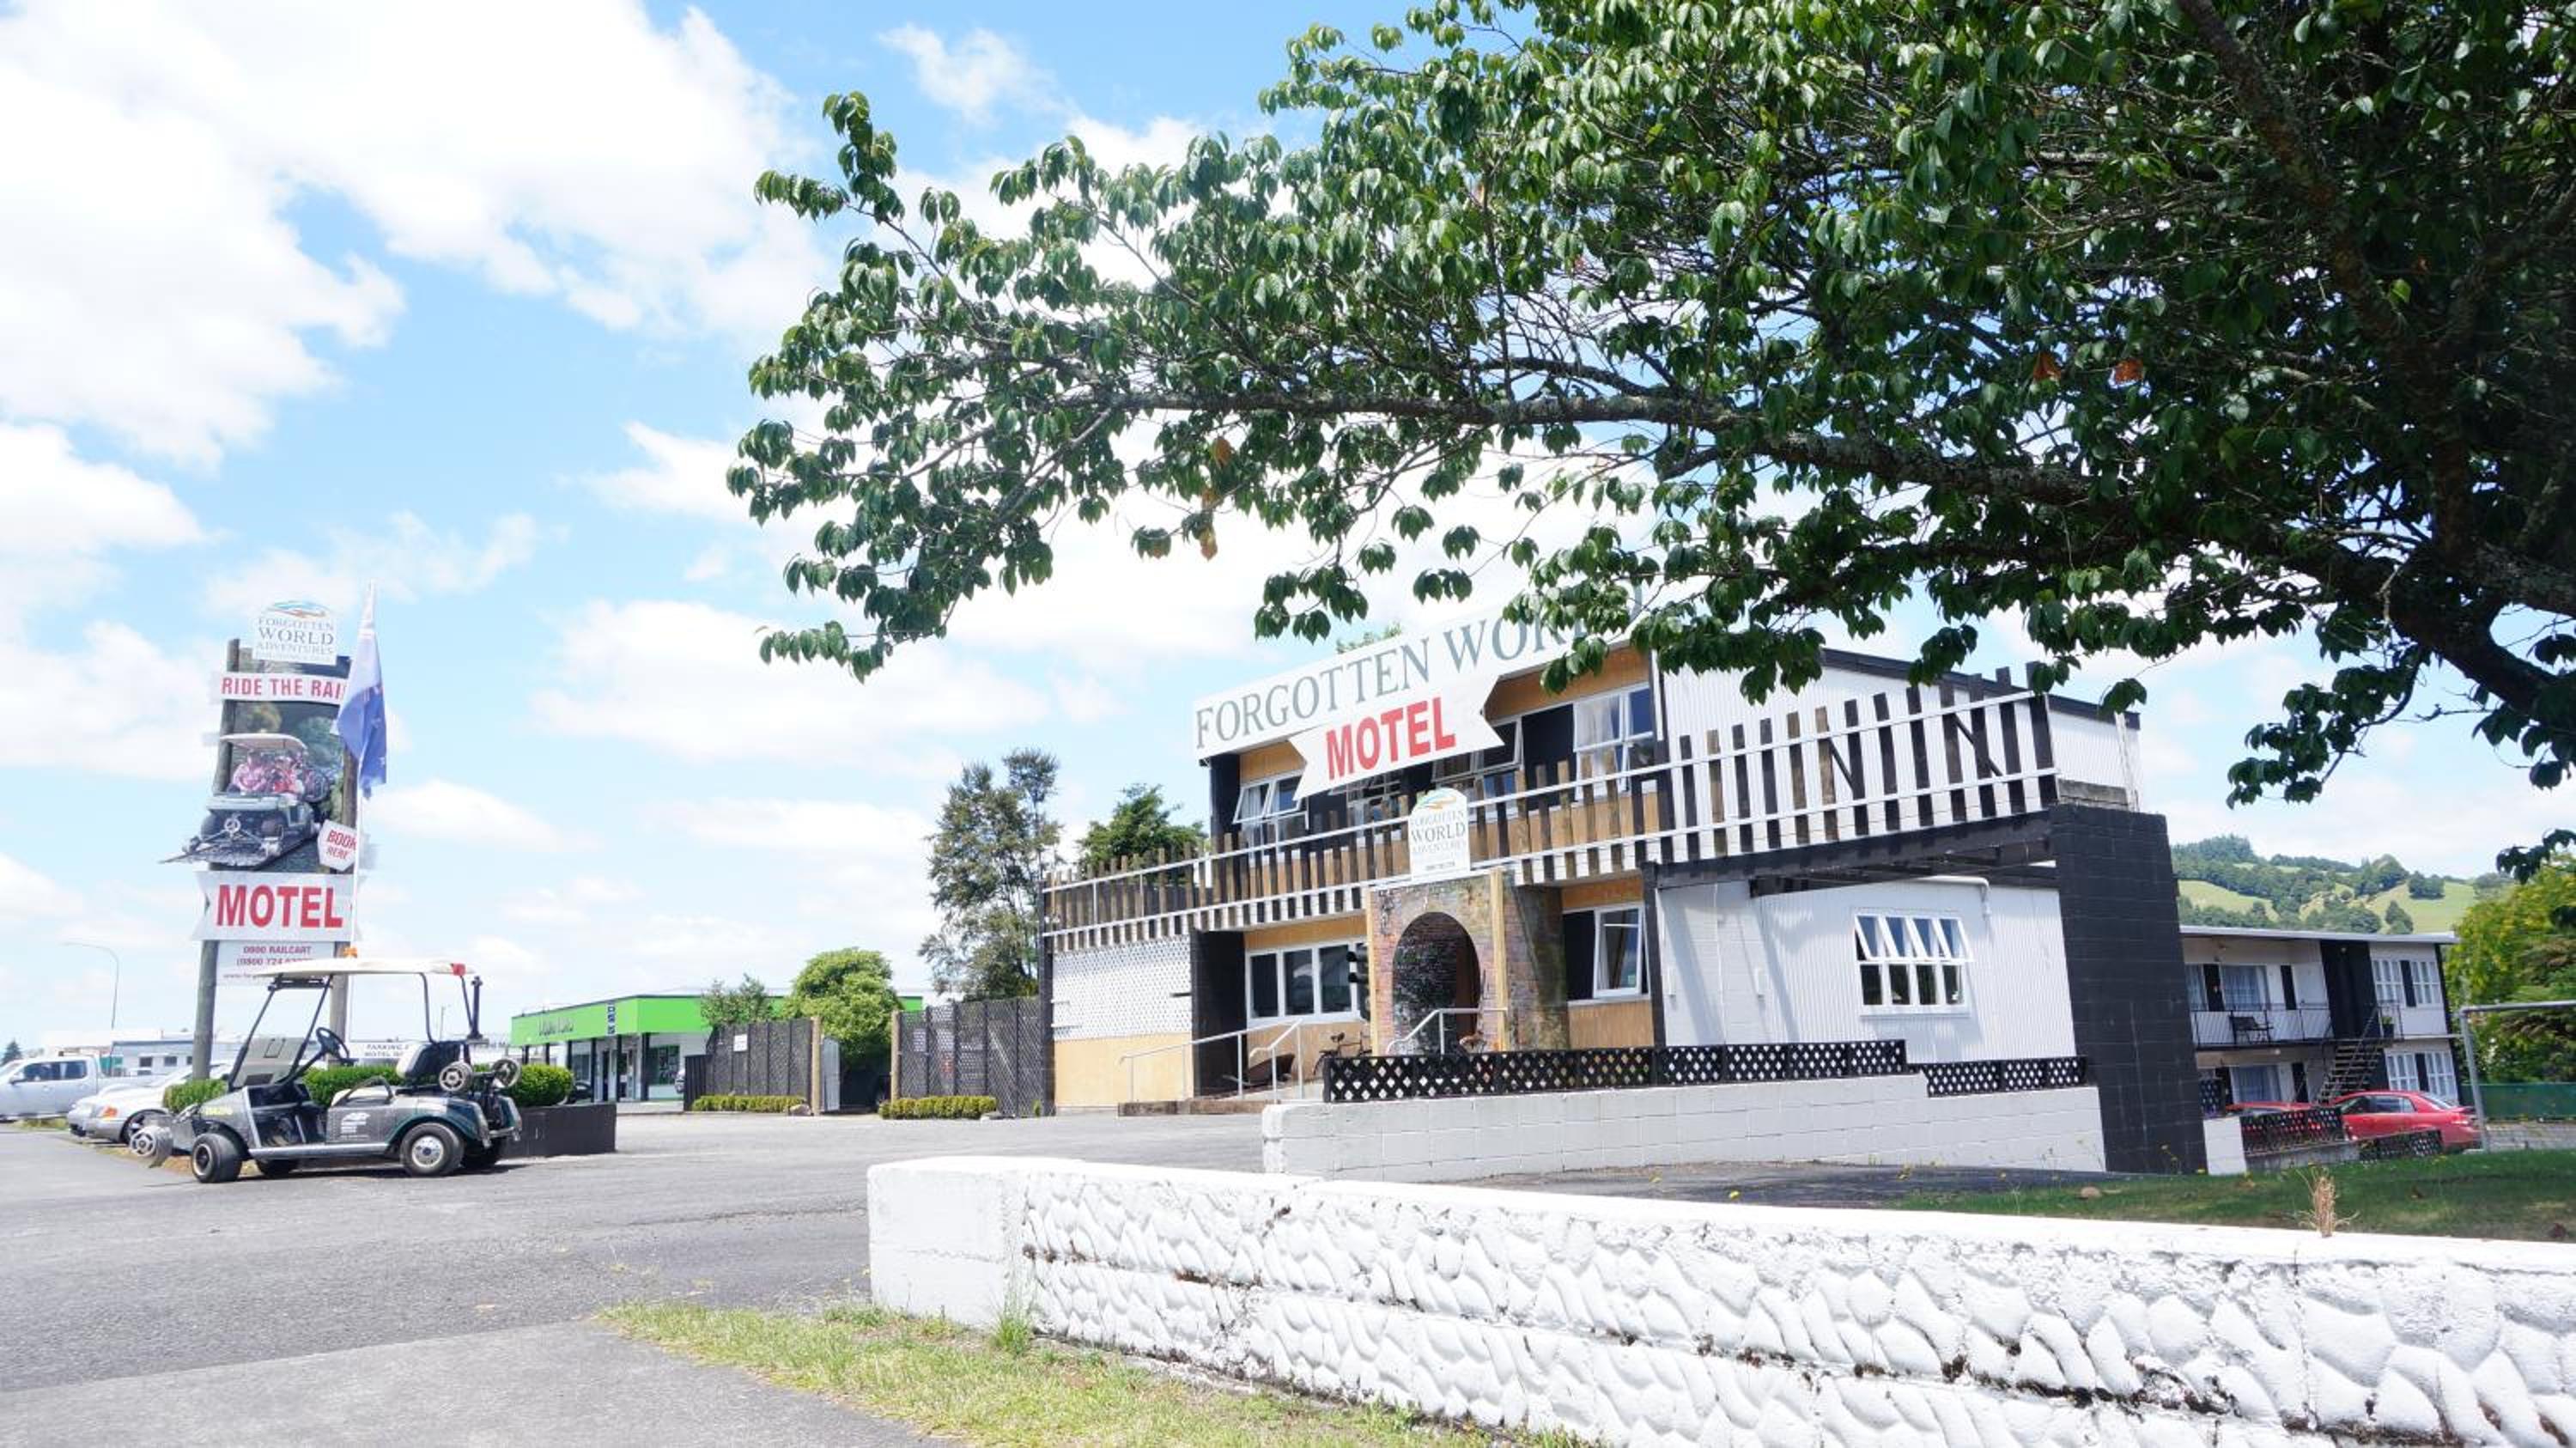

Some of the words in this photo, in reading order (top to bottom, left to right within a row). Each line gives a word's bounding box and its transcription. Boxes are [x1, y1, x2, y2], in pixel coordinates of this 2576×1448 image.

[258, 626, 334, 645] WORLD
[221, 677, 262, 696] RIDE
[270, 678, 303, 697] THE
[1196, 636, 1430, 750] FORGOTTEN
[1326, 697, 1457, 782] MOTEL
[1411, 822, 1466, 843] WORLD
[216, 884, 343, 928] MOTEL
[269, 946, 312, 954] RAILCART
